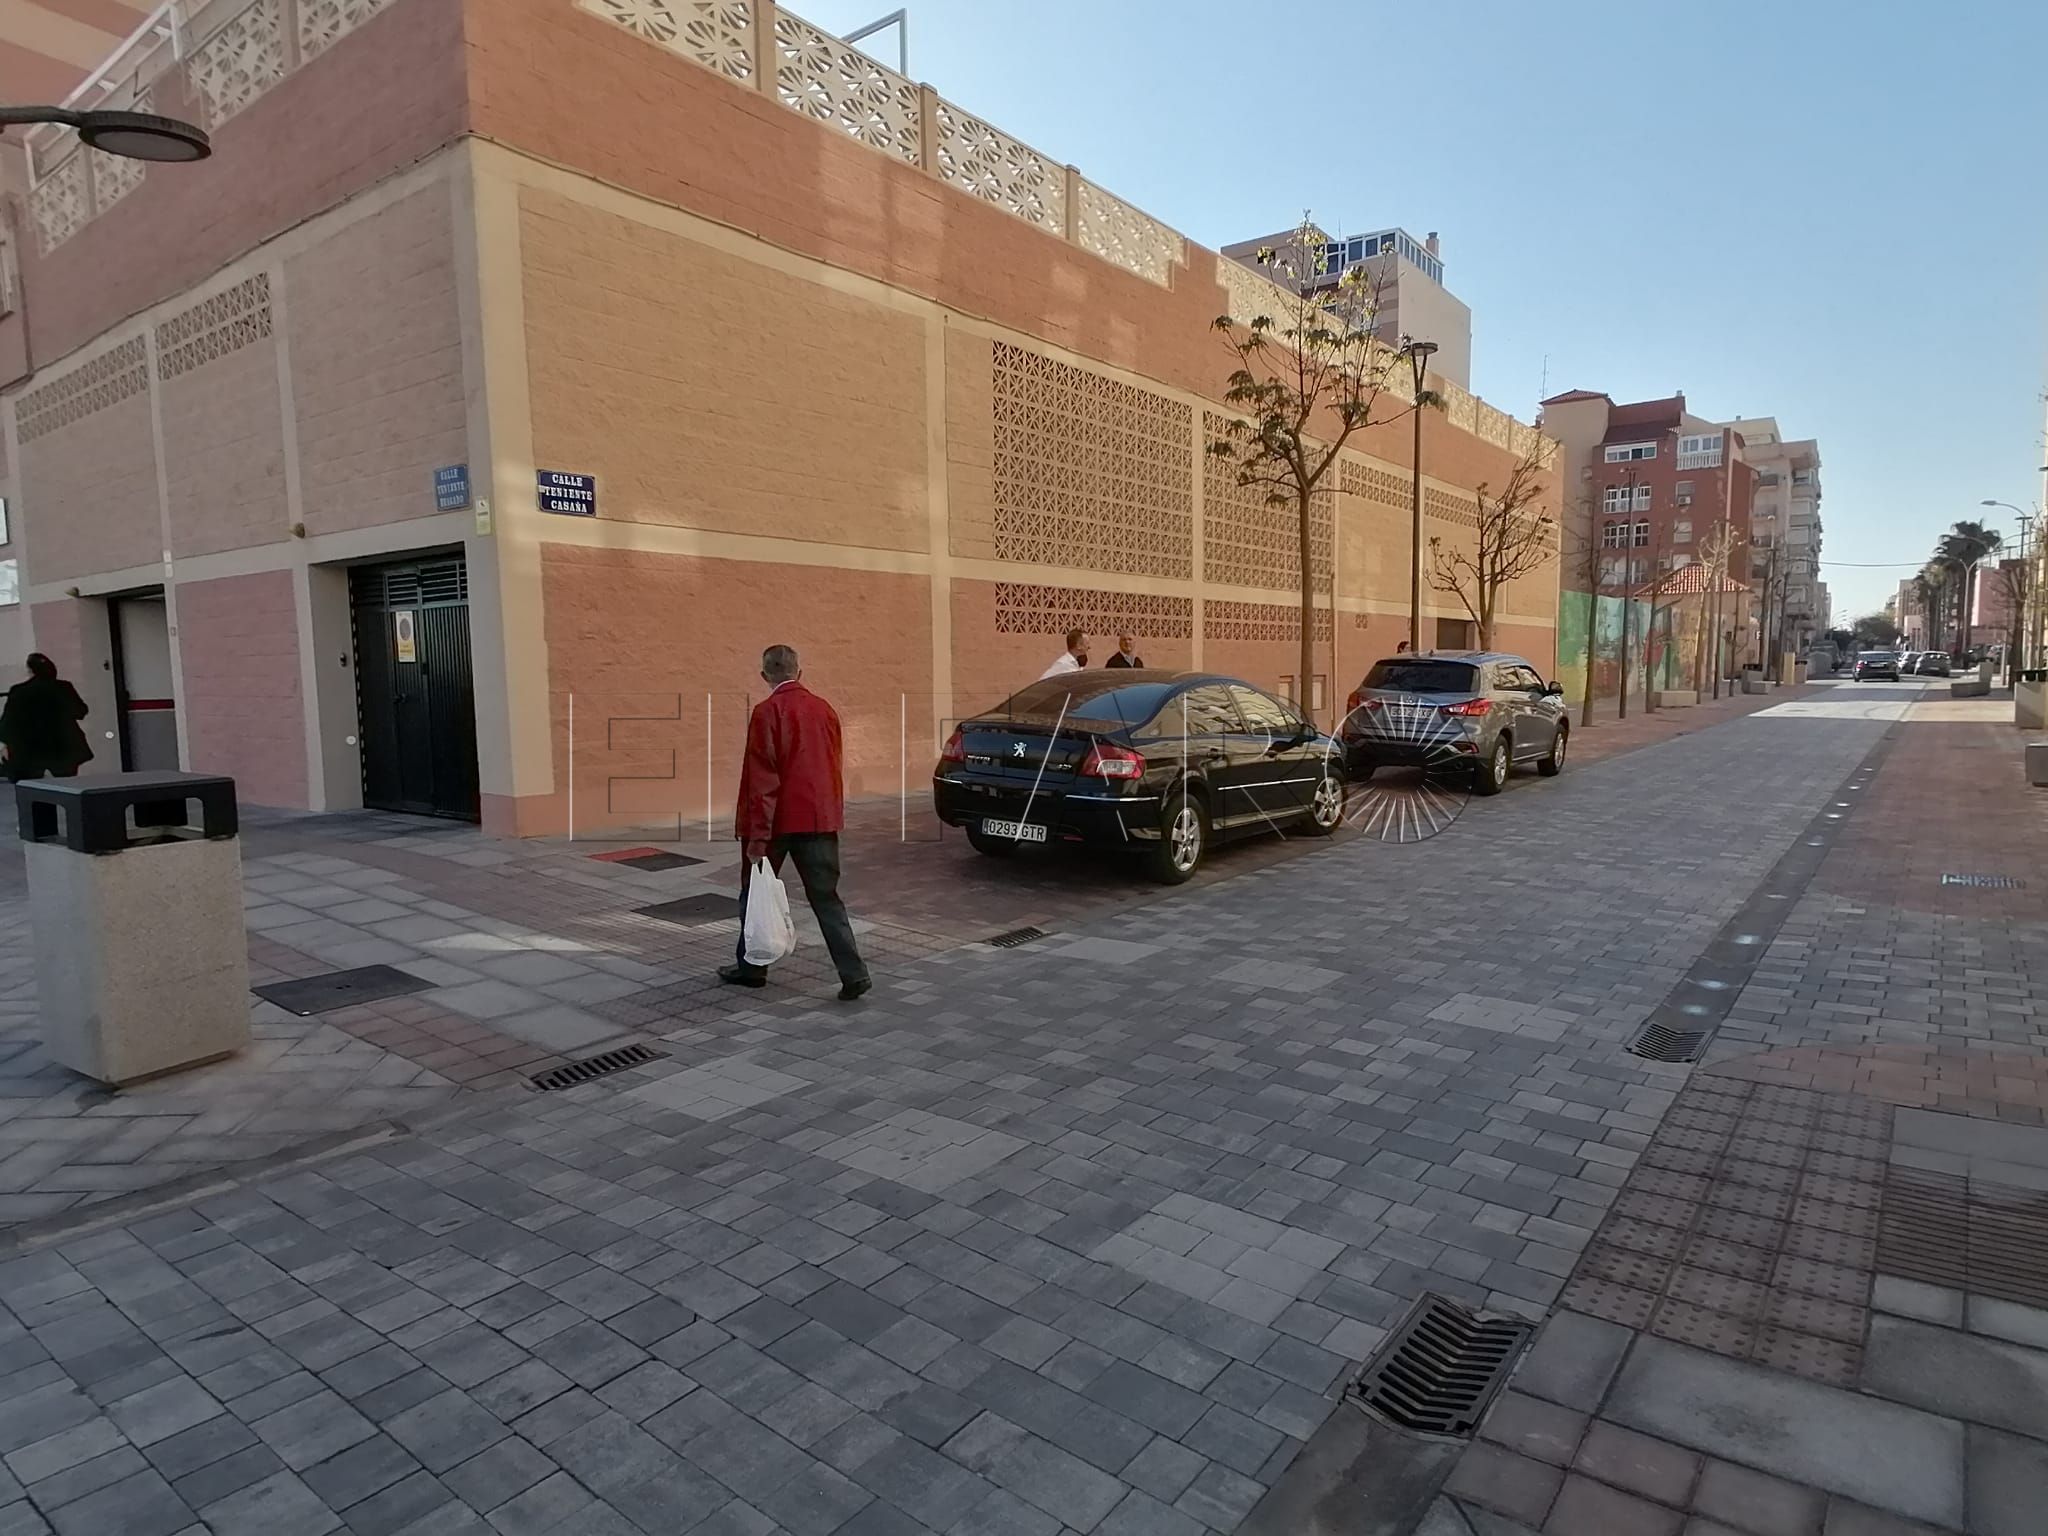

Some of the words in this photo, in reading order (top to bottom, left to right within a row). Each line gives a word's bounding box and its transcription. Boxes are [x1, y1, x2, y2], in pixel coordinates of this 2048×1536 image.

[551, 474, 583, 487] CALLE
[544, 486, 593, 501] TENIENTE
[550, 500, 587, 513] CASAÑA
[989, 821, 1018, 836] 0293
[1021, 825, 1044, 841] GTR
